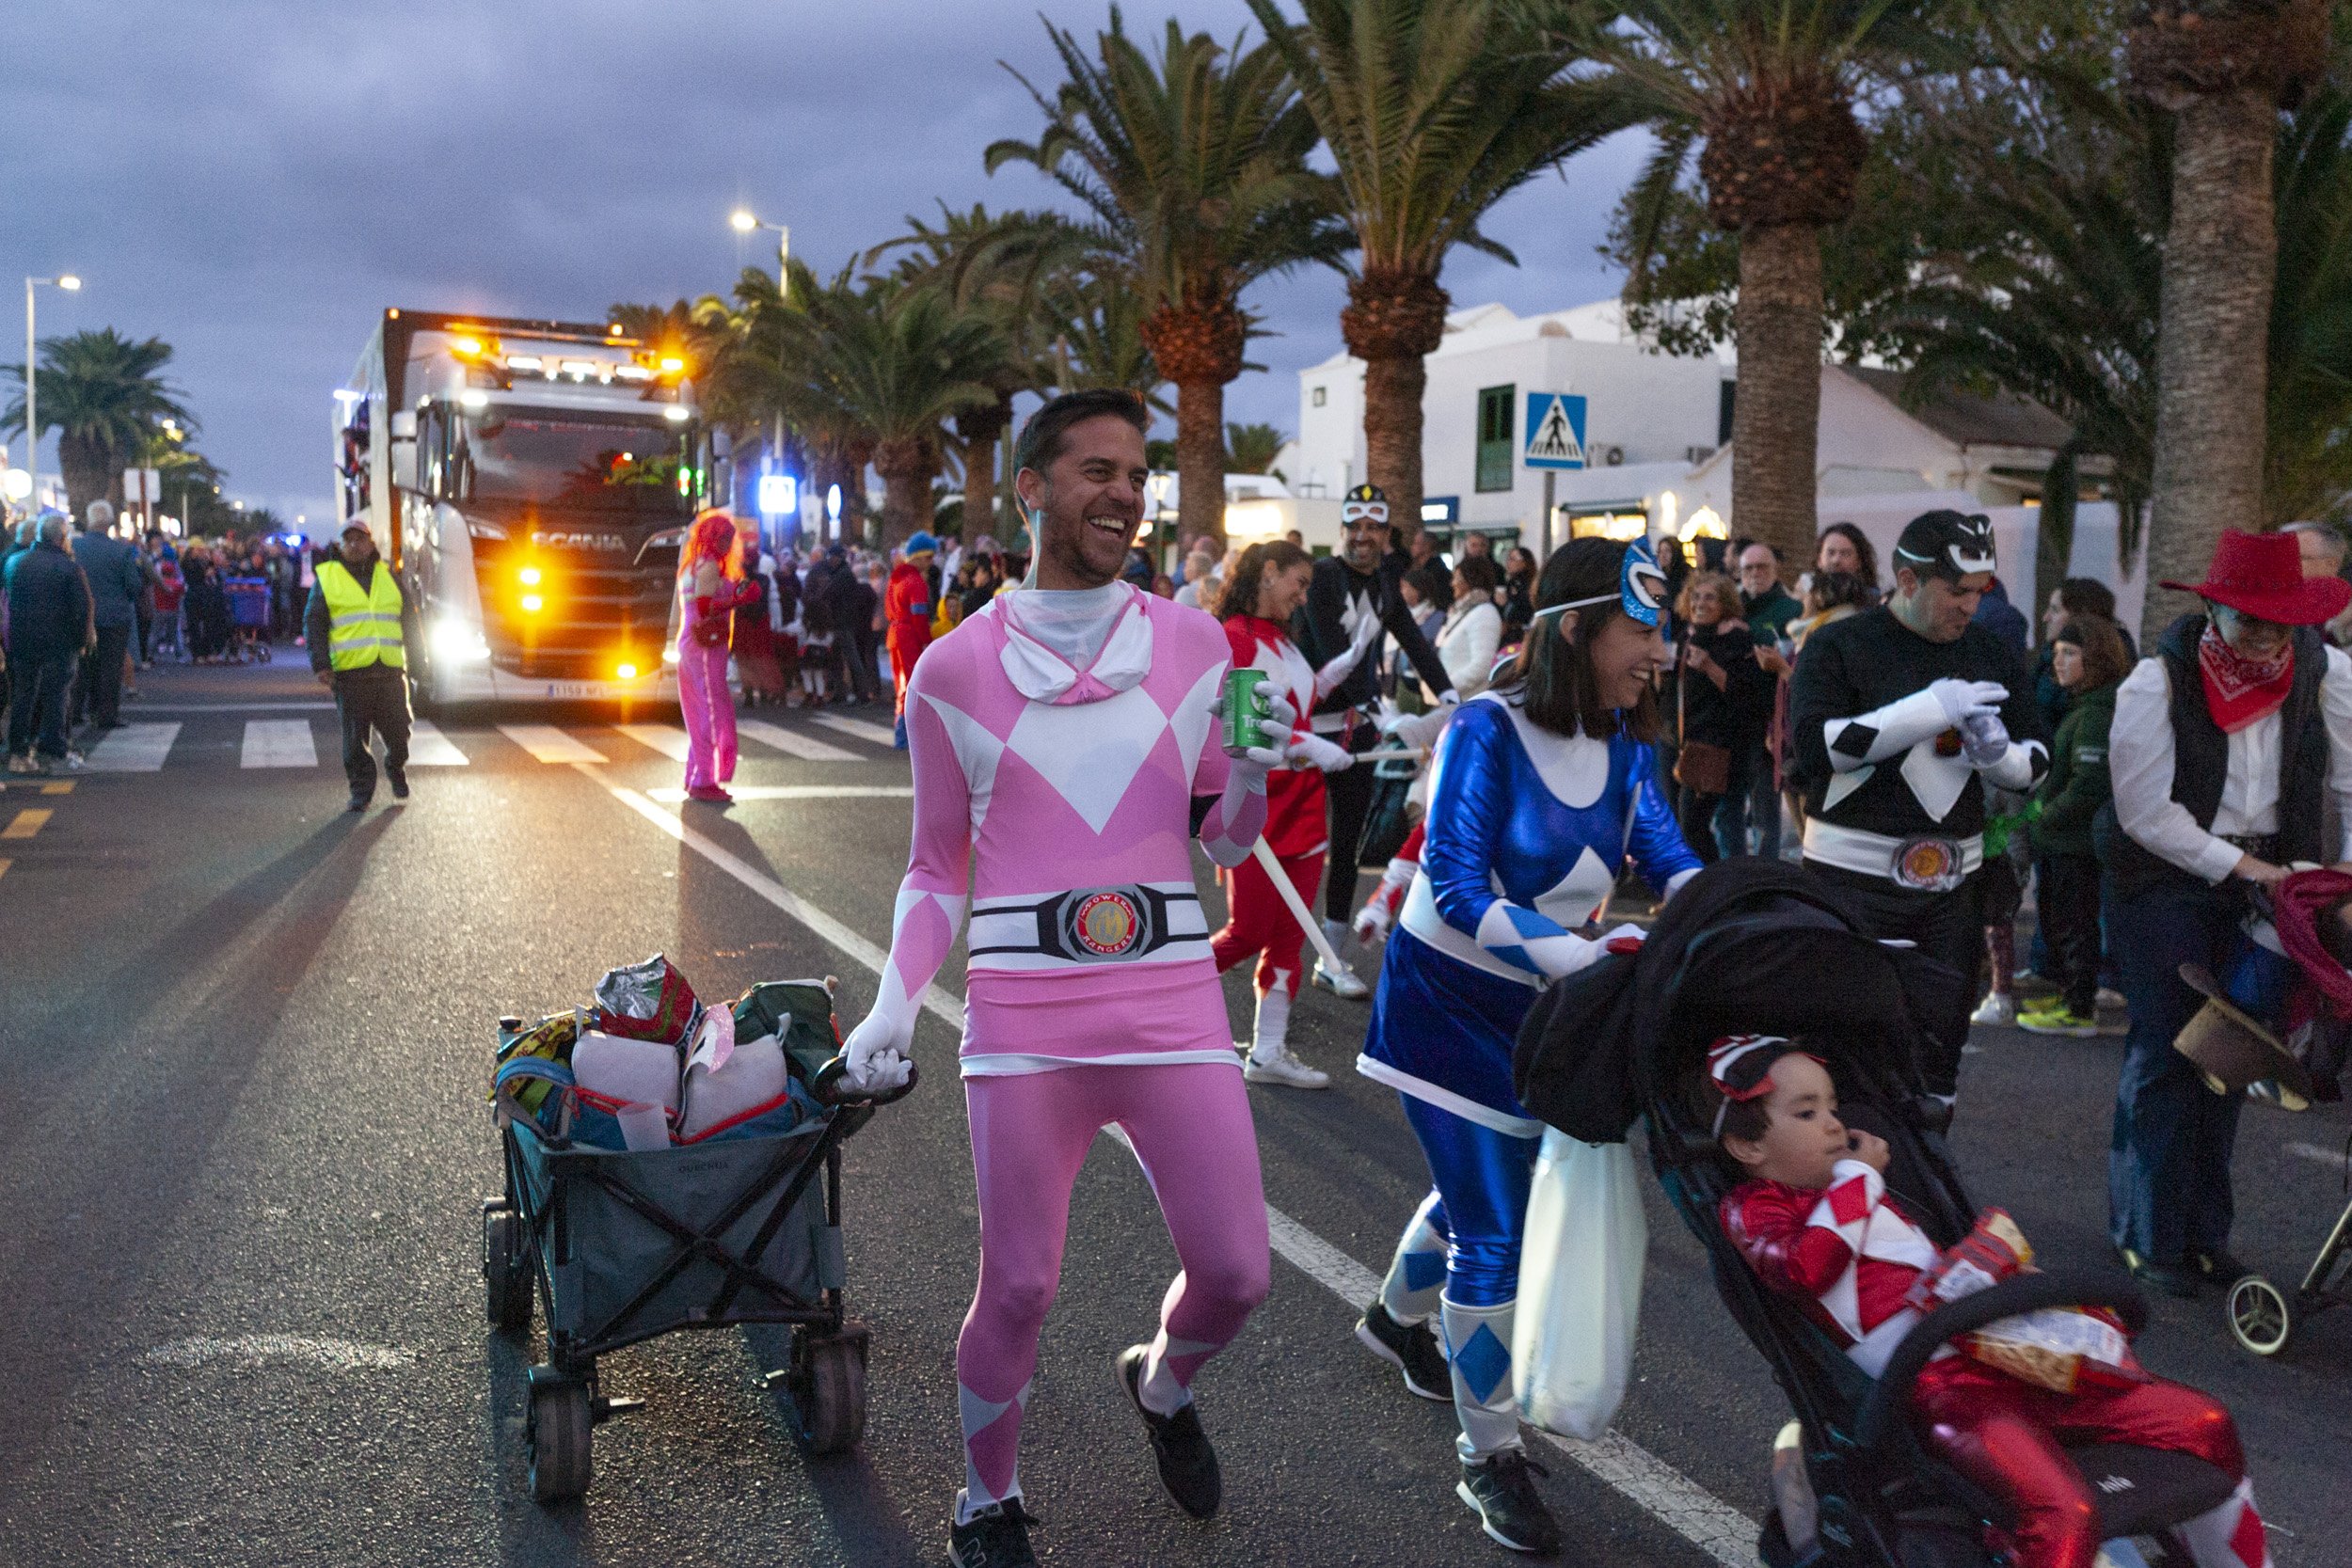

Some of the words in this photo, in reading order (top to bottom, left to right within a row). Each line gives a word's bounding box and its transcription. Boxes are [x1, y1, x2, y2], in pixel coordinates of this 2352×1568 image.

[532, 531, 627, 552] SCANIA
[1242, 714, 1263, 729] Tro
[1081, 895, 1132, 916] POWER
[1082, 934, 1132, 952] RANGERS
